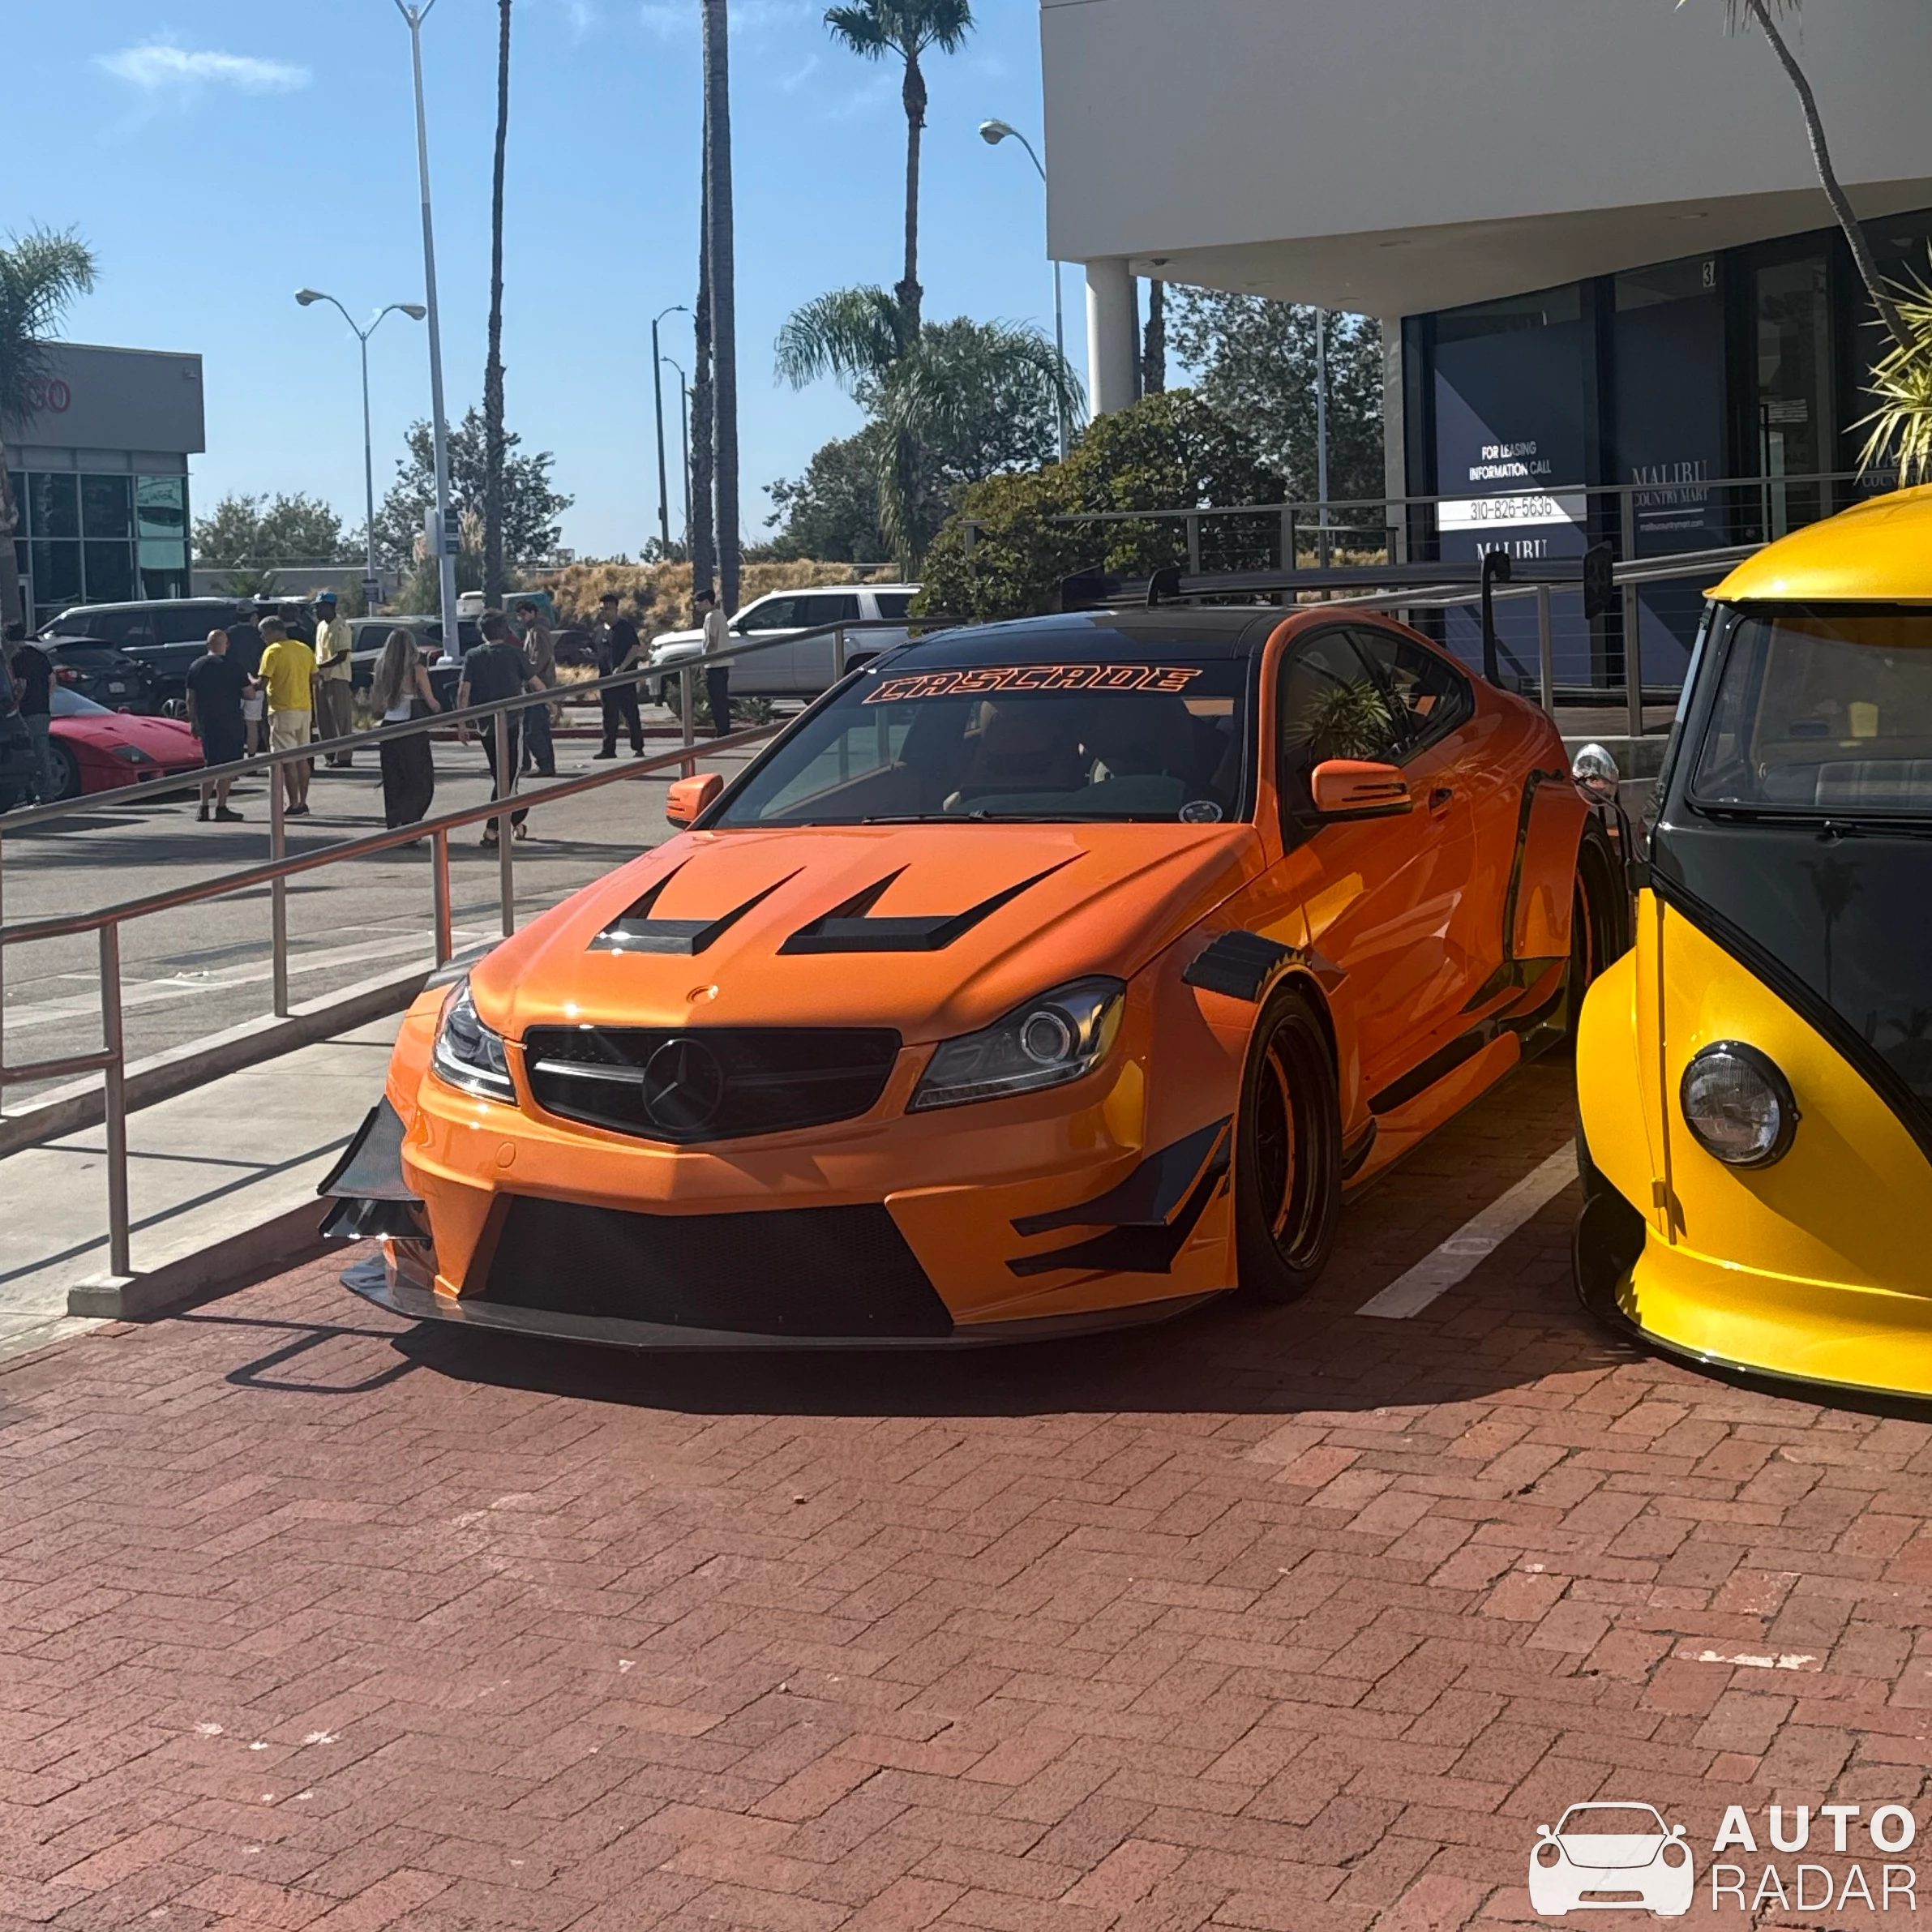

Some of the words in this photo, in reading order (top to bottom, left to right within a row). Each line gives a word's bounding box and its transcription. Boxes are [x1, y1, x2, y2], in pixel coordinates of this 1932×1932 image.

[1481, 445, 1499, 460] FOR
[1500, 441, 1537, 458] LEASING
[1469, 462, 1528, 481] INFORMATION
[1529, 460, 1552, 474] CALL
[1632, 461, 1707, 485] MALIBU
[1470, 495, 1552, 520] 310-826-5636
[1634, 488, 1678, 507] COUNTRY
[1680, 486, 1710, 503] MART
[862, 665, 1203, 705] CASCADE
